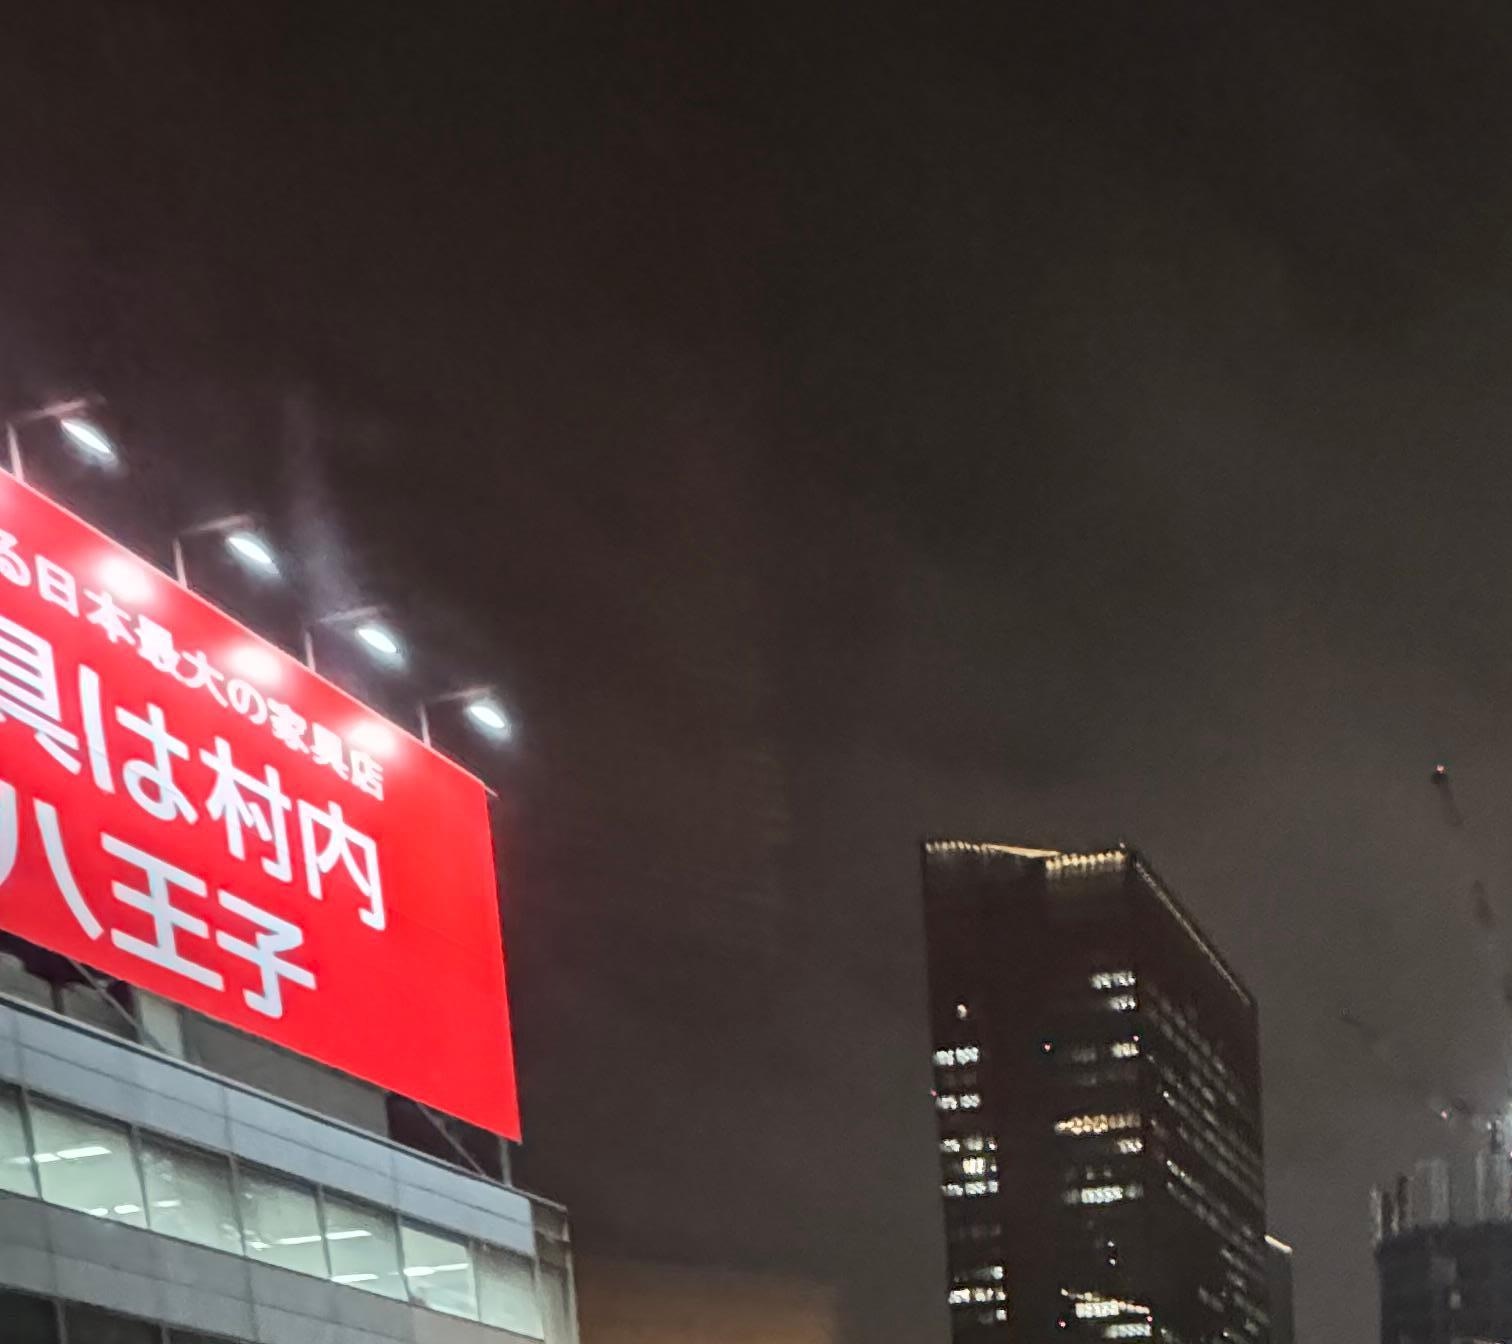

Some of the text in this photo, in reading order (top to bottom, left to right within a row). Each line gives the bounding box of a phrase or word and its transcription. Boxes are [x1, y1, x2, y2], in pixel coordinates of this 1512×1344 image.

[0, 614, 386, 931] 具は村内
[0, 778, 315, 1019] 八王子
